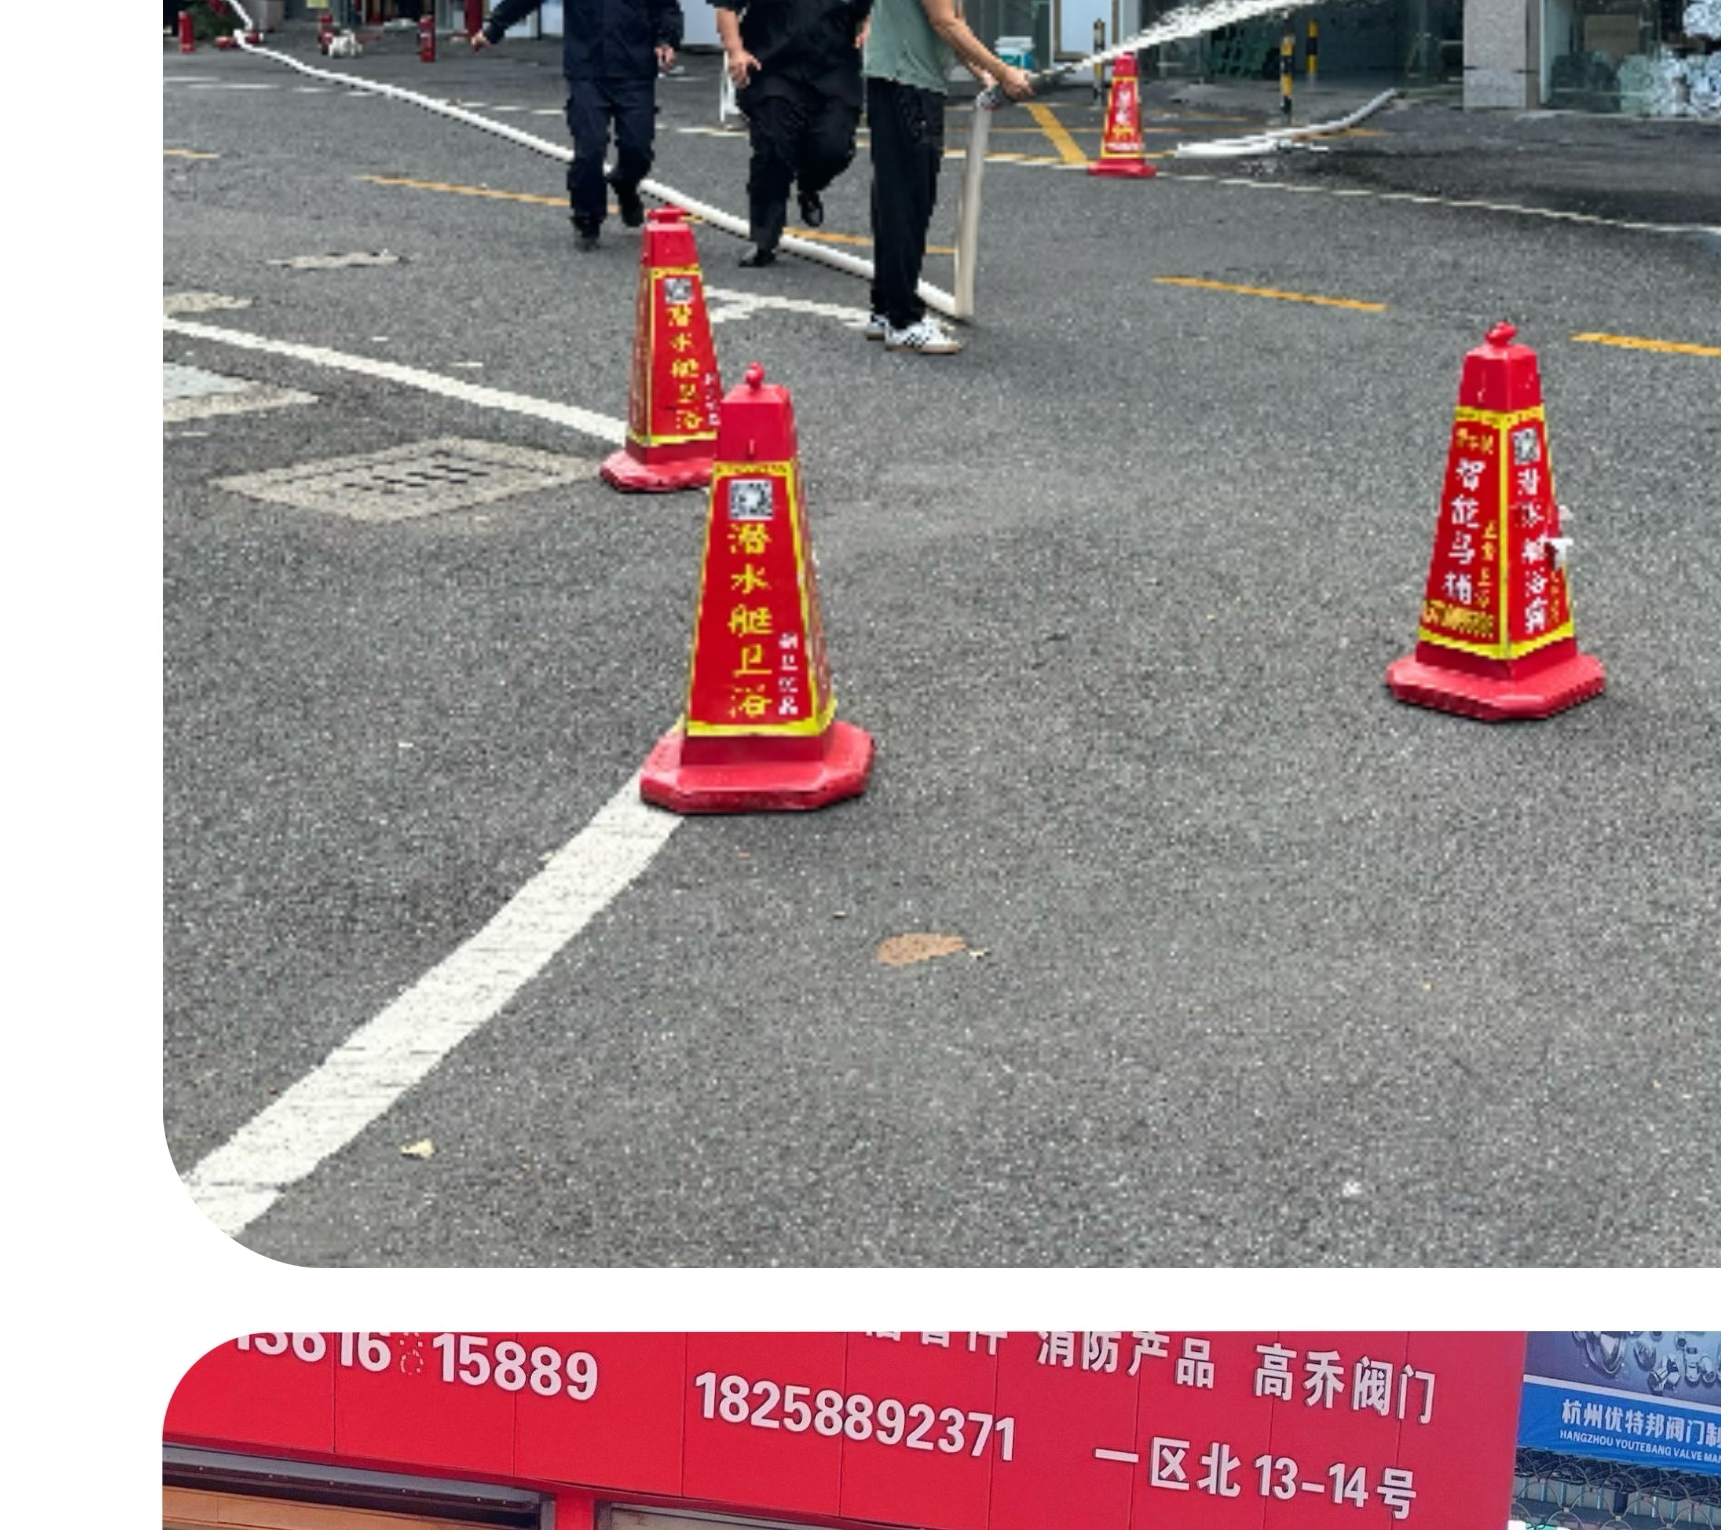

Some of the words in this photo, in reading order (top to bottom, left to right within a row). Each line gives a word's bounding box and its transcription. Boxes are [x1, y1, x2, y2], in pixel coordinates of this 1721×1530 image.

[727, 523, 774, 720] 潜水艇卫浴
[694, 1372, 1016, 1463] 18258892371
[1037, 1332, 1216, 1389] 消防产品
[1254, 1343, 1436, 1424] 高乔阀门
[1560, 1429, 1615, 1447] HANGZHOU
[1615, 1436, 1672, 1457] YOUTEBANG
[1672, 1447, 1703, 1462] VALVE
